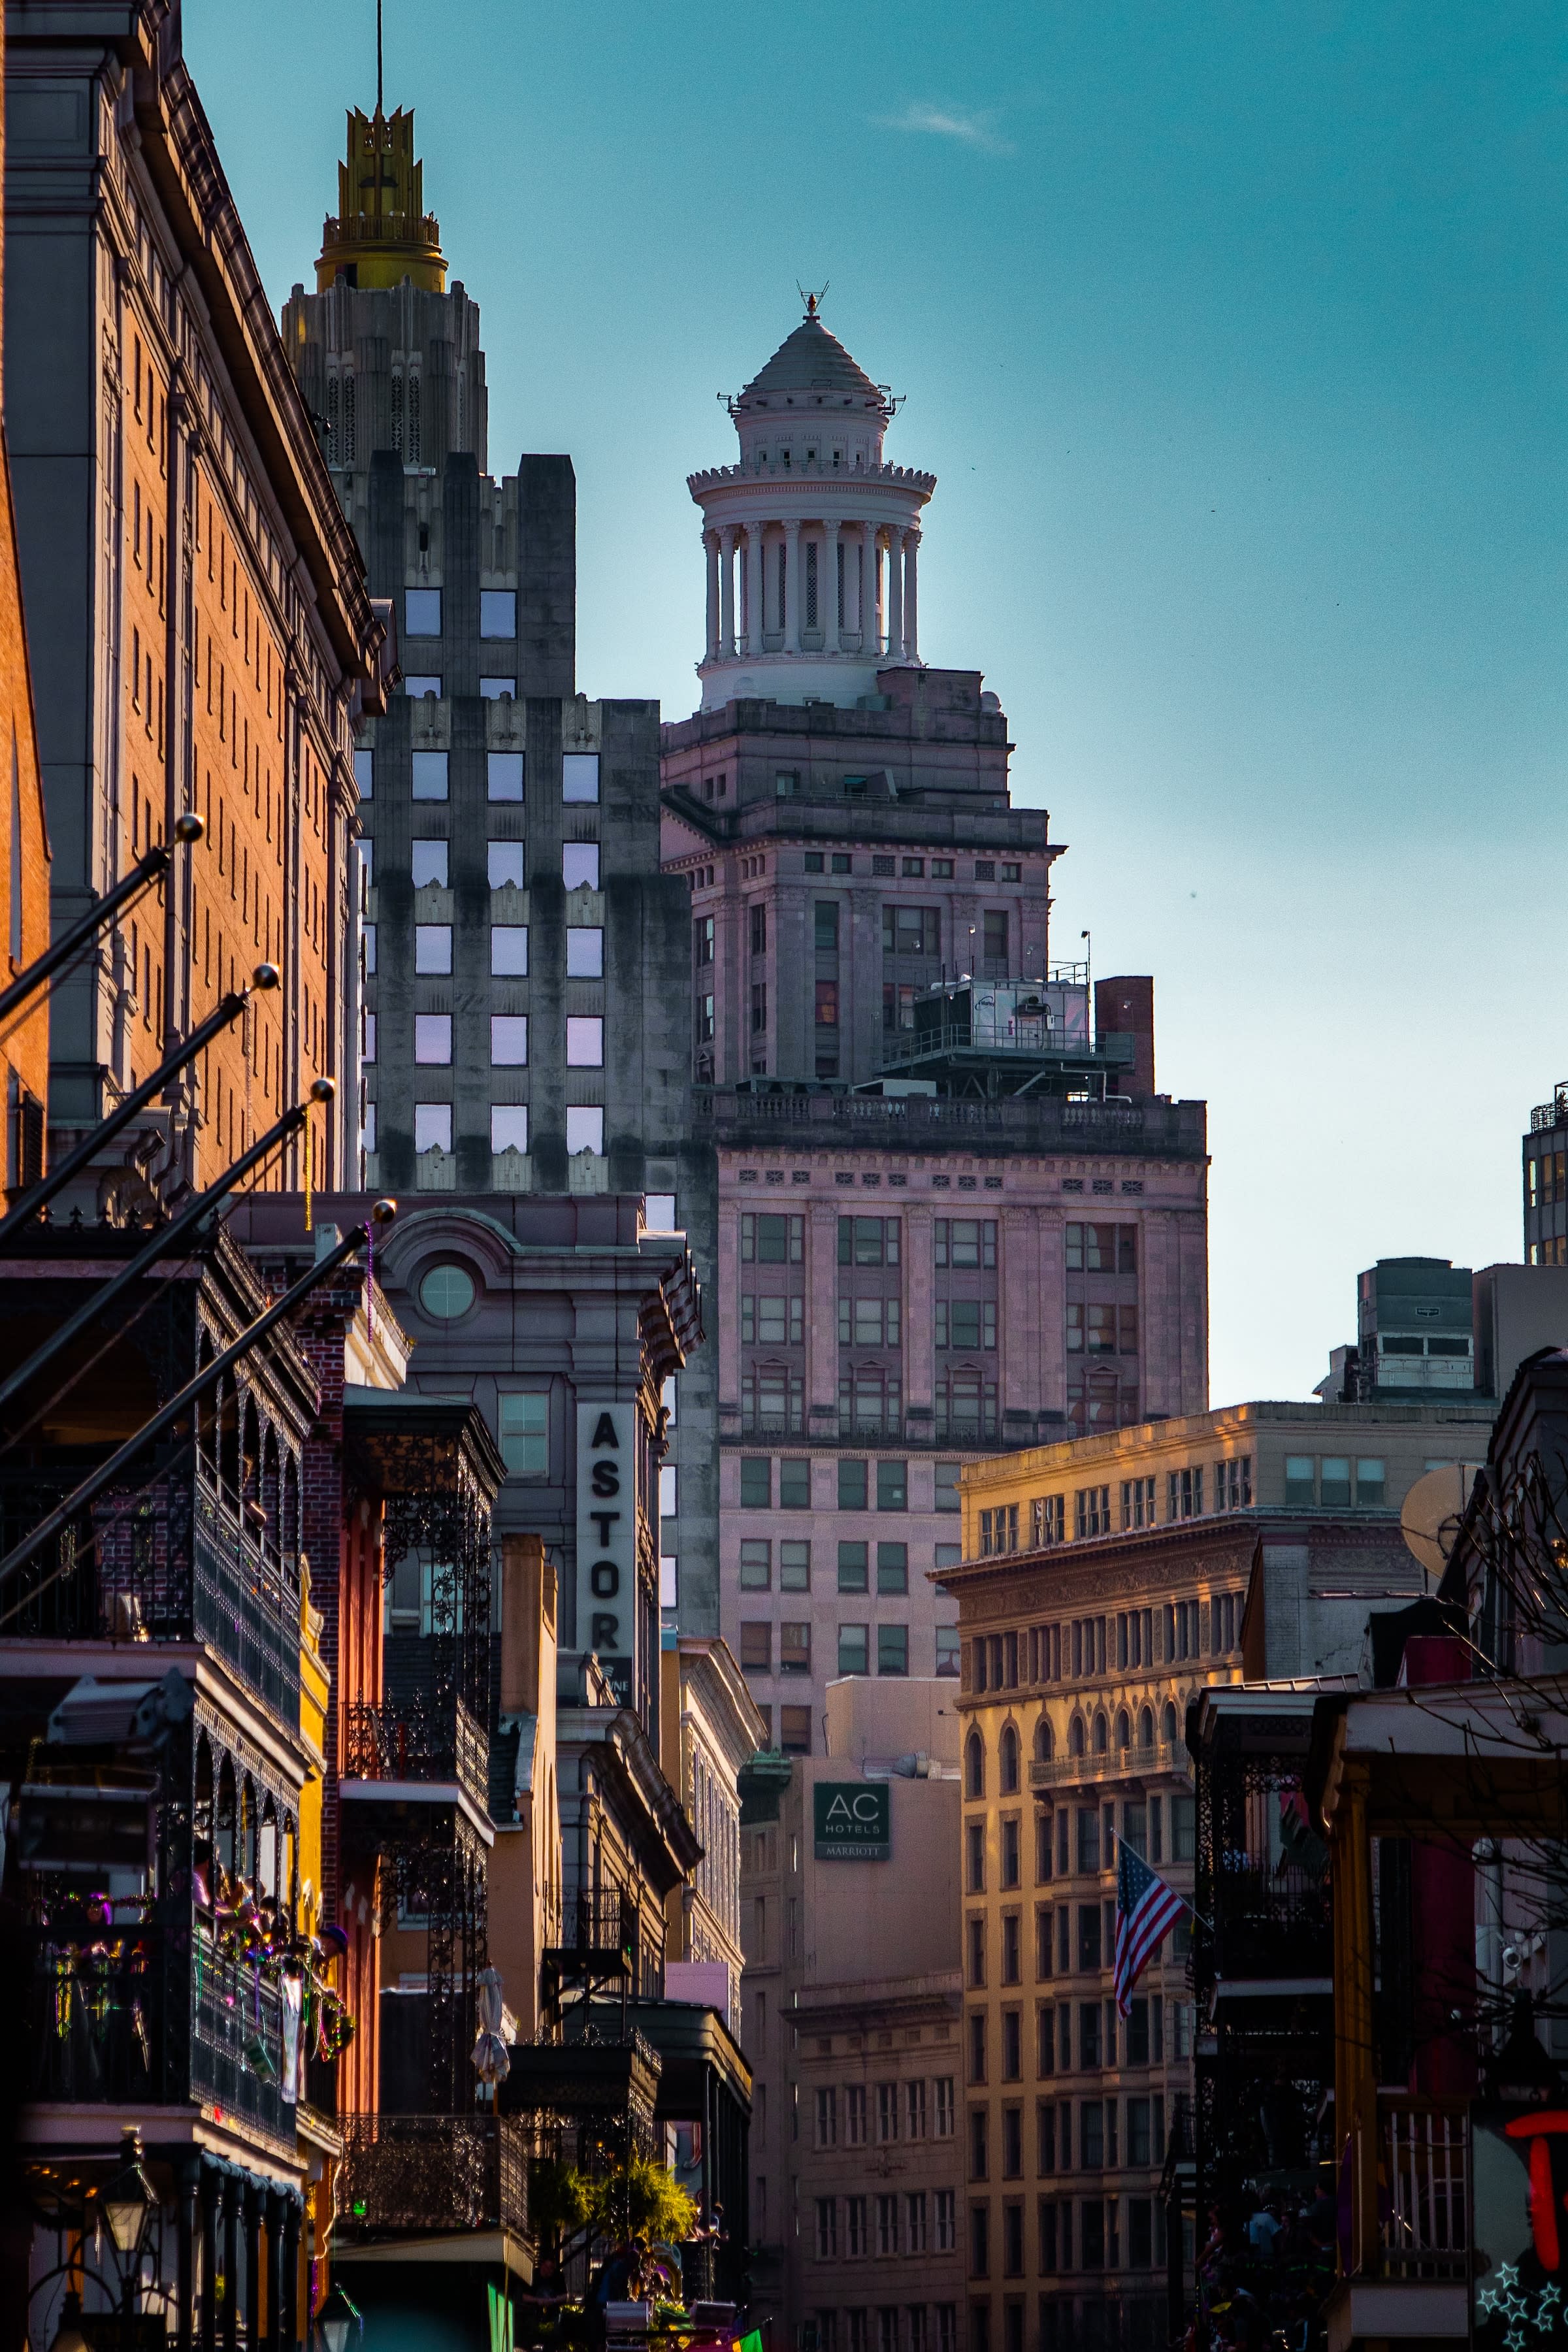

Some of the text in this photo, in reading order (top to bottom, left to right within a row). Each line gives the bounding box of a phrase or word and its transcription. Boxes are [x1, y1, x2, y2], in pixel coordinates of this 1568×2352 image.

[590, 1412, 620, 1649] ASTOR
[826, 1793, 879, 1821] AC
[826, 1825, 879, 1834] HOTELS
[826, 1847, 879, 1856] MARRIOTT
